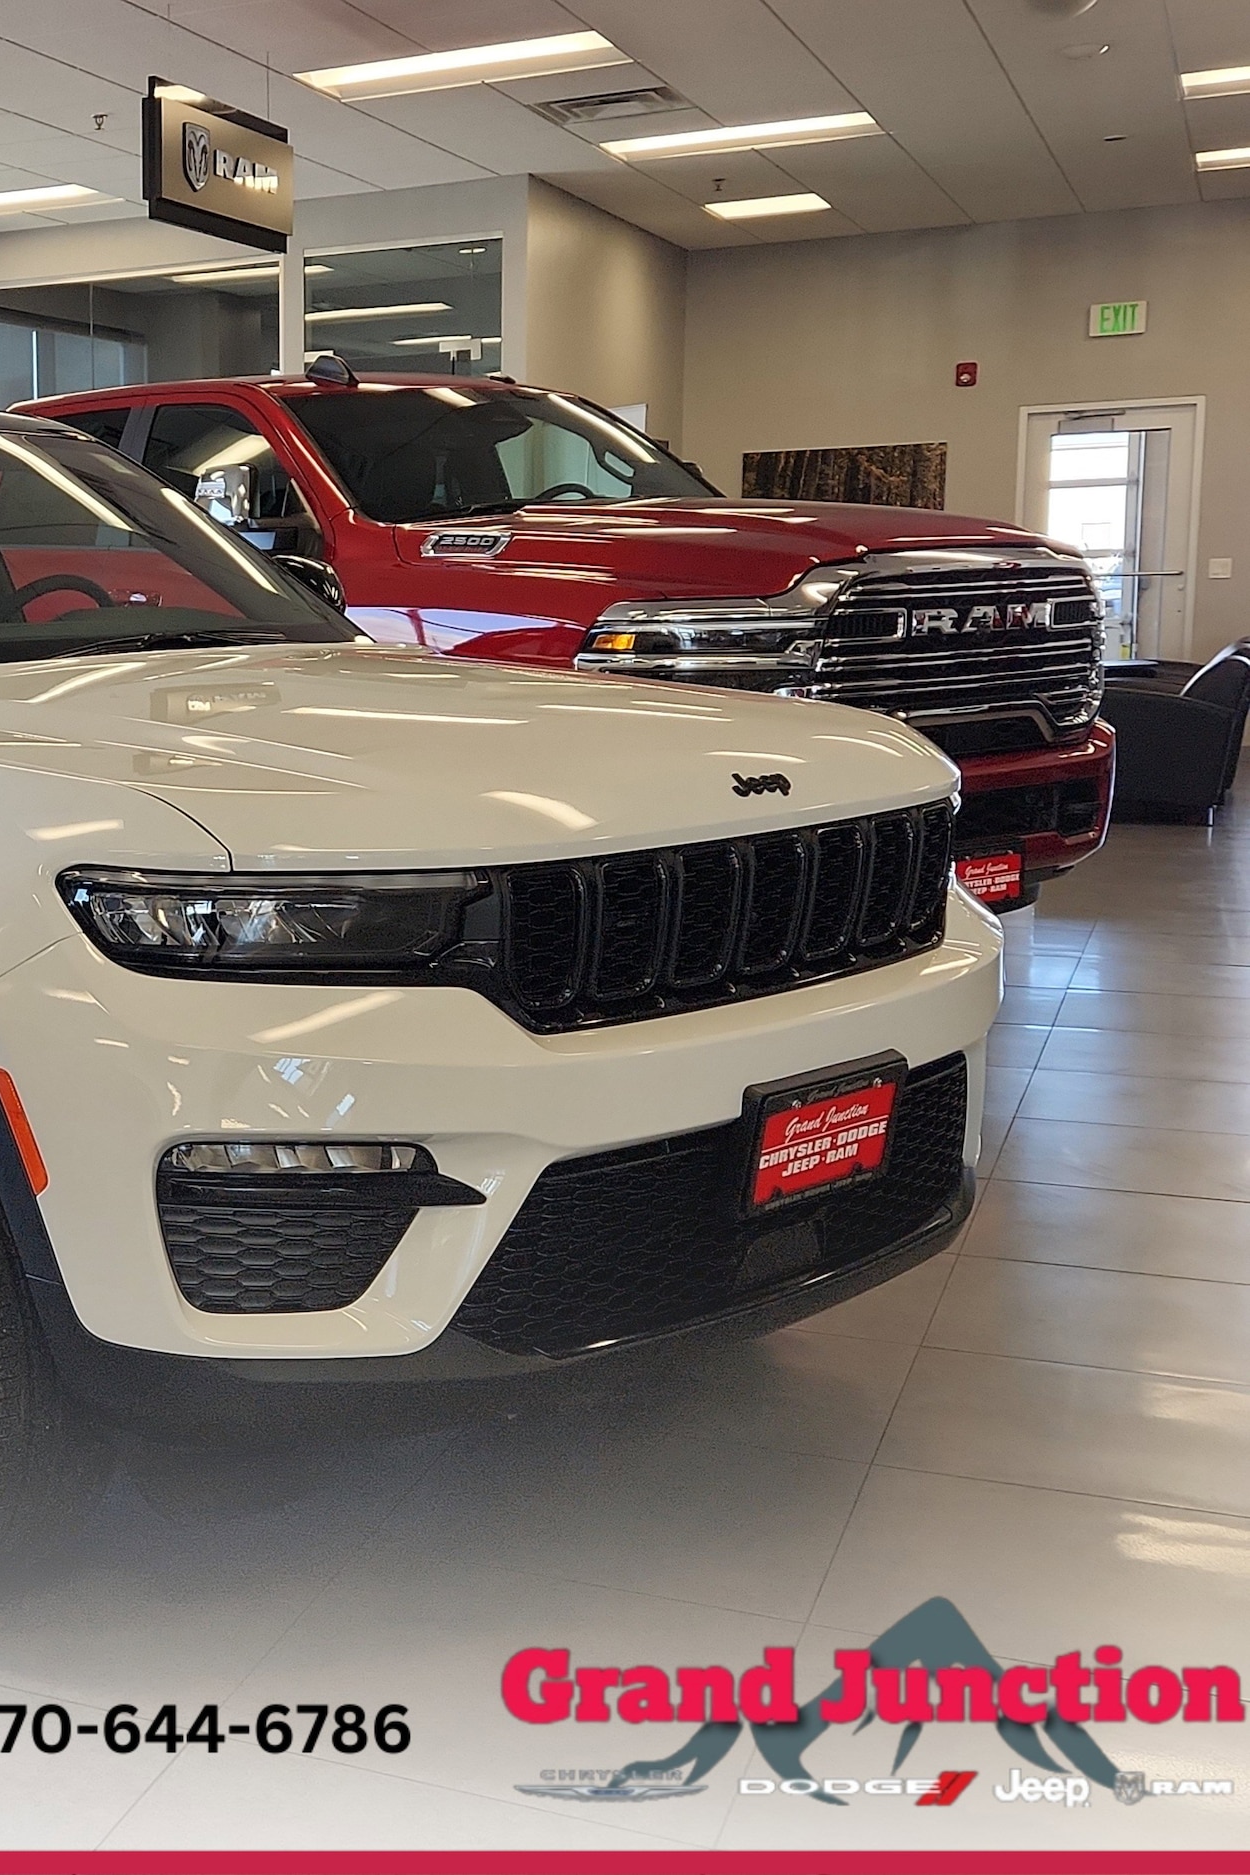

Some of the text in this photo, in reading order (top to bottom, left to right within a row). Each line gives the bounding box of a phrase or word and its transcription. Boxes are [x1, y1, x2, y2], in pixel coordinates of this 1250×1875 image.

[213, 149, 279, 195] RAM
[1099, 303, 1139, 333] EXIT
[440, 536, 495, 546] 2500
[910, 602, 1049, 637] RAM
[731, 773, 792, 797] Jeep
[785, 1103, 870, 1144] Grand Junction
[759, 1120, 888, 1170] CHRYSLER DODGE
[781, 1143, 859, 1177] JEEP RAM
